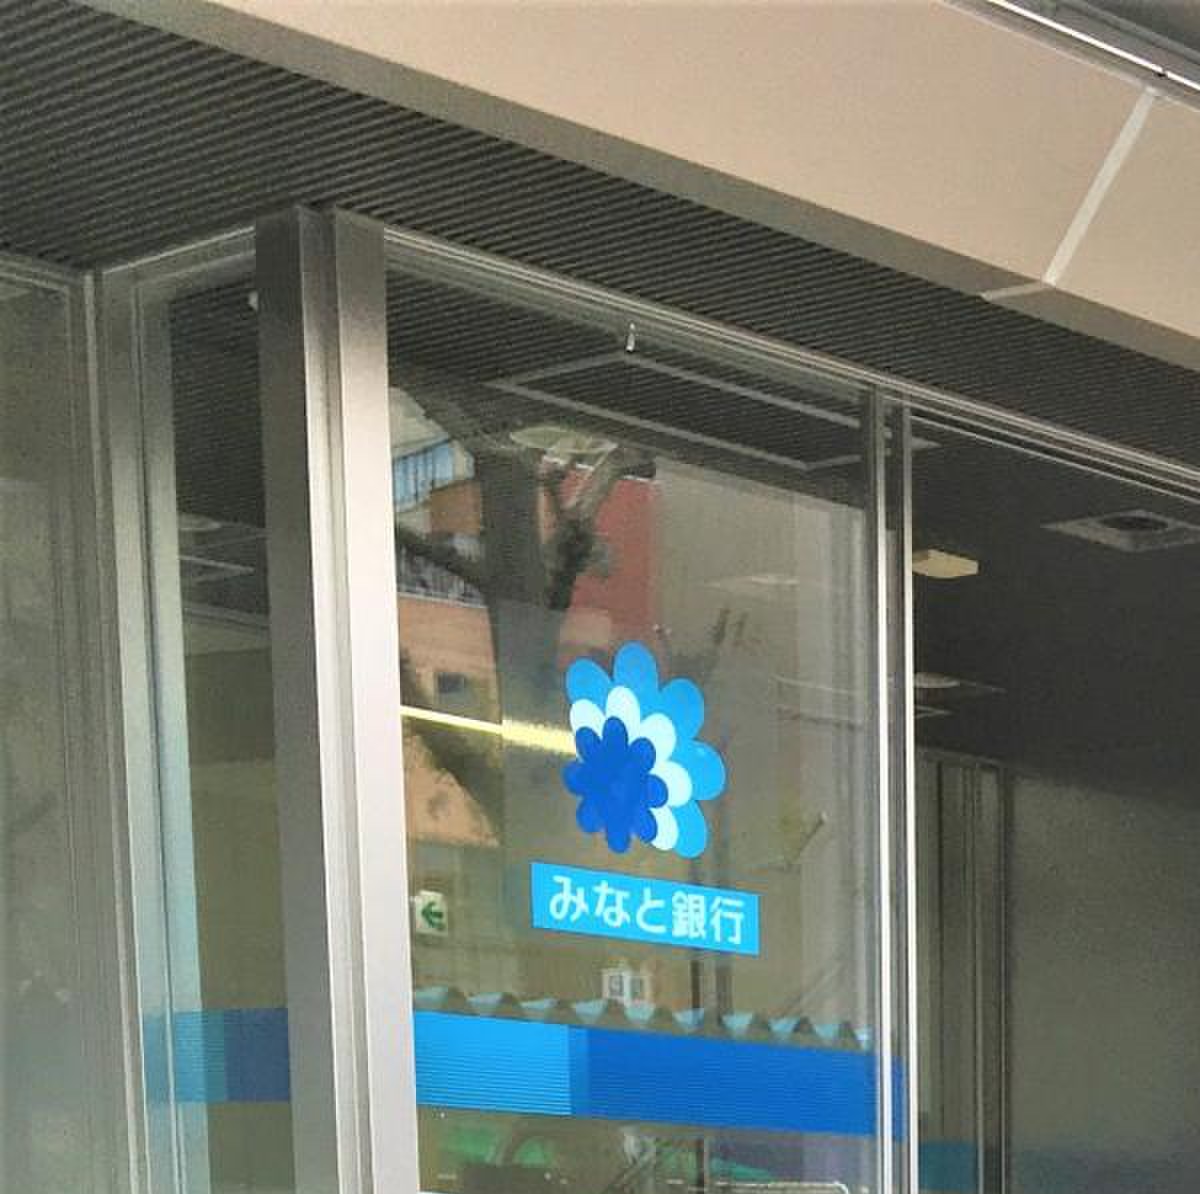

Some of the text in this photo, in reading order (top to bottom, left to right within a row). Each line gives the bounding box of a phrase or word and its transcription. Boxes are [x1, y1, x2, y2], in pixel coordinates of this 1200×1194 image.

[548, 876, 745, 946] みなと銀行
